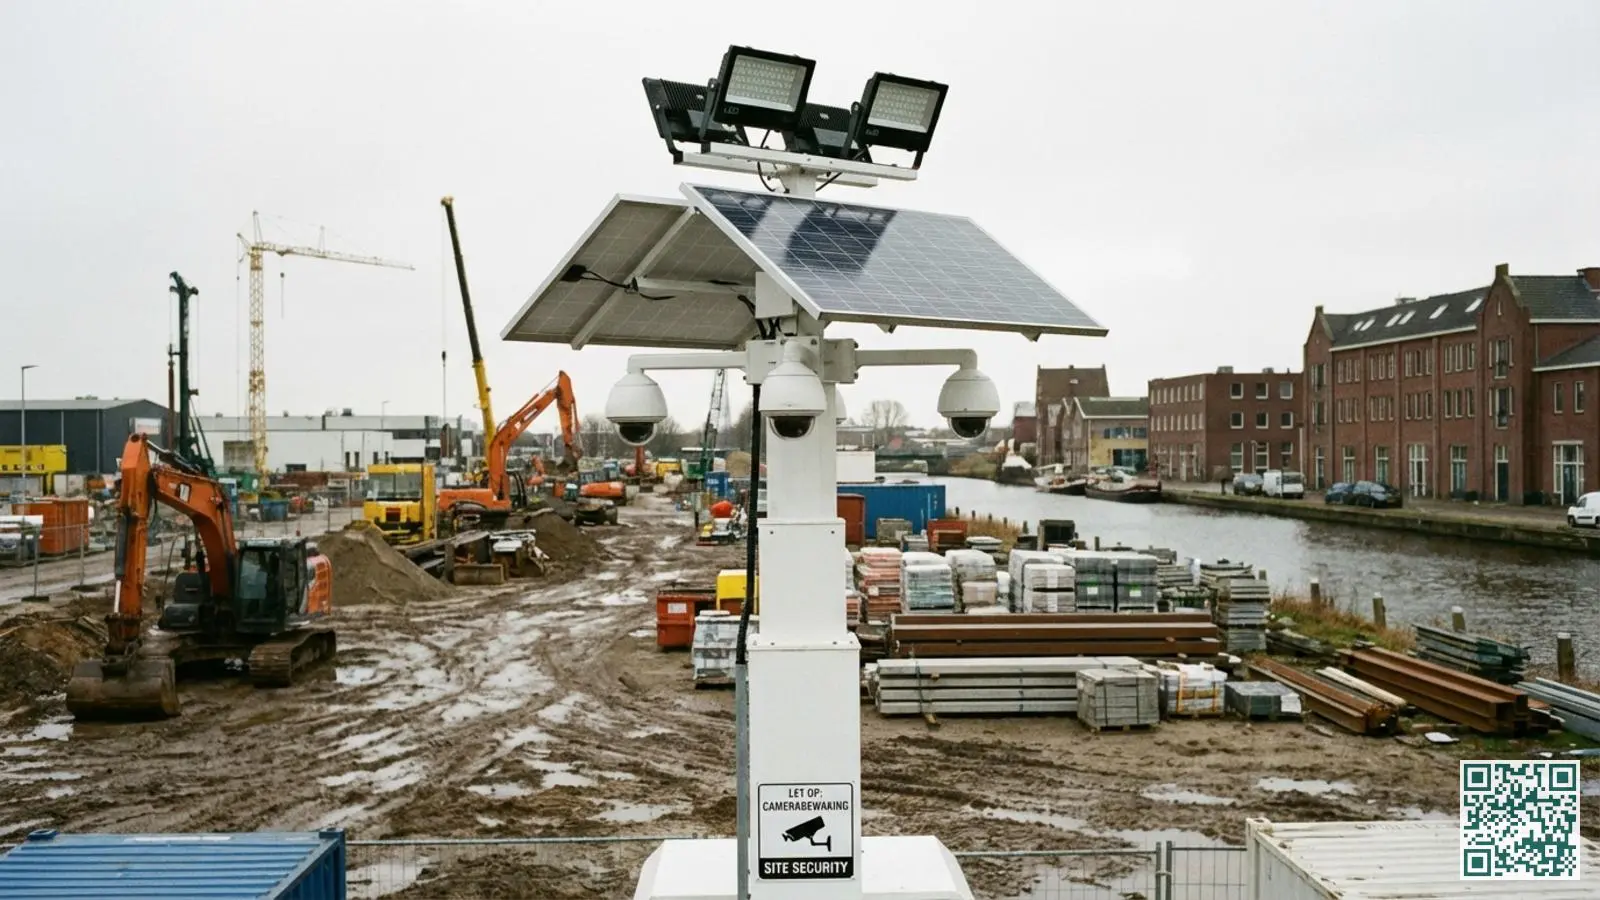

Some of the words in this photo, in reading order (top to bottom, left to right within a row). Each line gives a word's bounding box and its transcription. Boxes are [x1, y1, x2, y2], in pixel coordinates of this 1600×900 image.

[788, 788, 804, 798] LET
[764, 862, 789, 874] SITE
[792, 861, 848, 874] SECURITY
